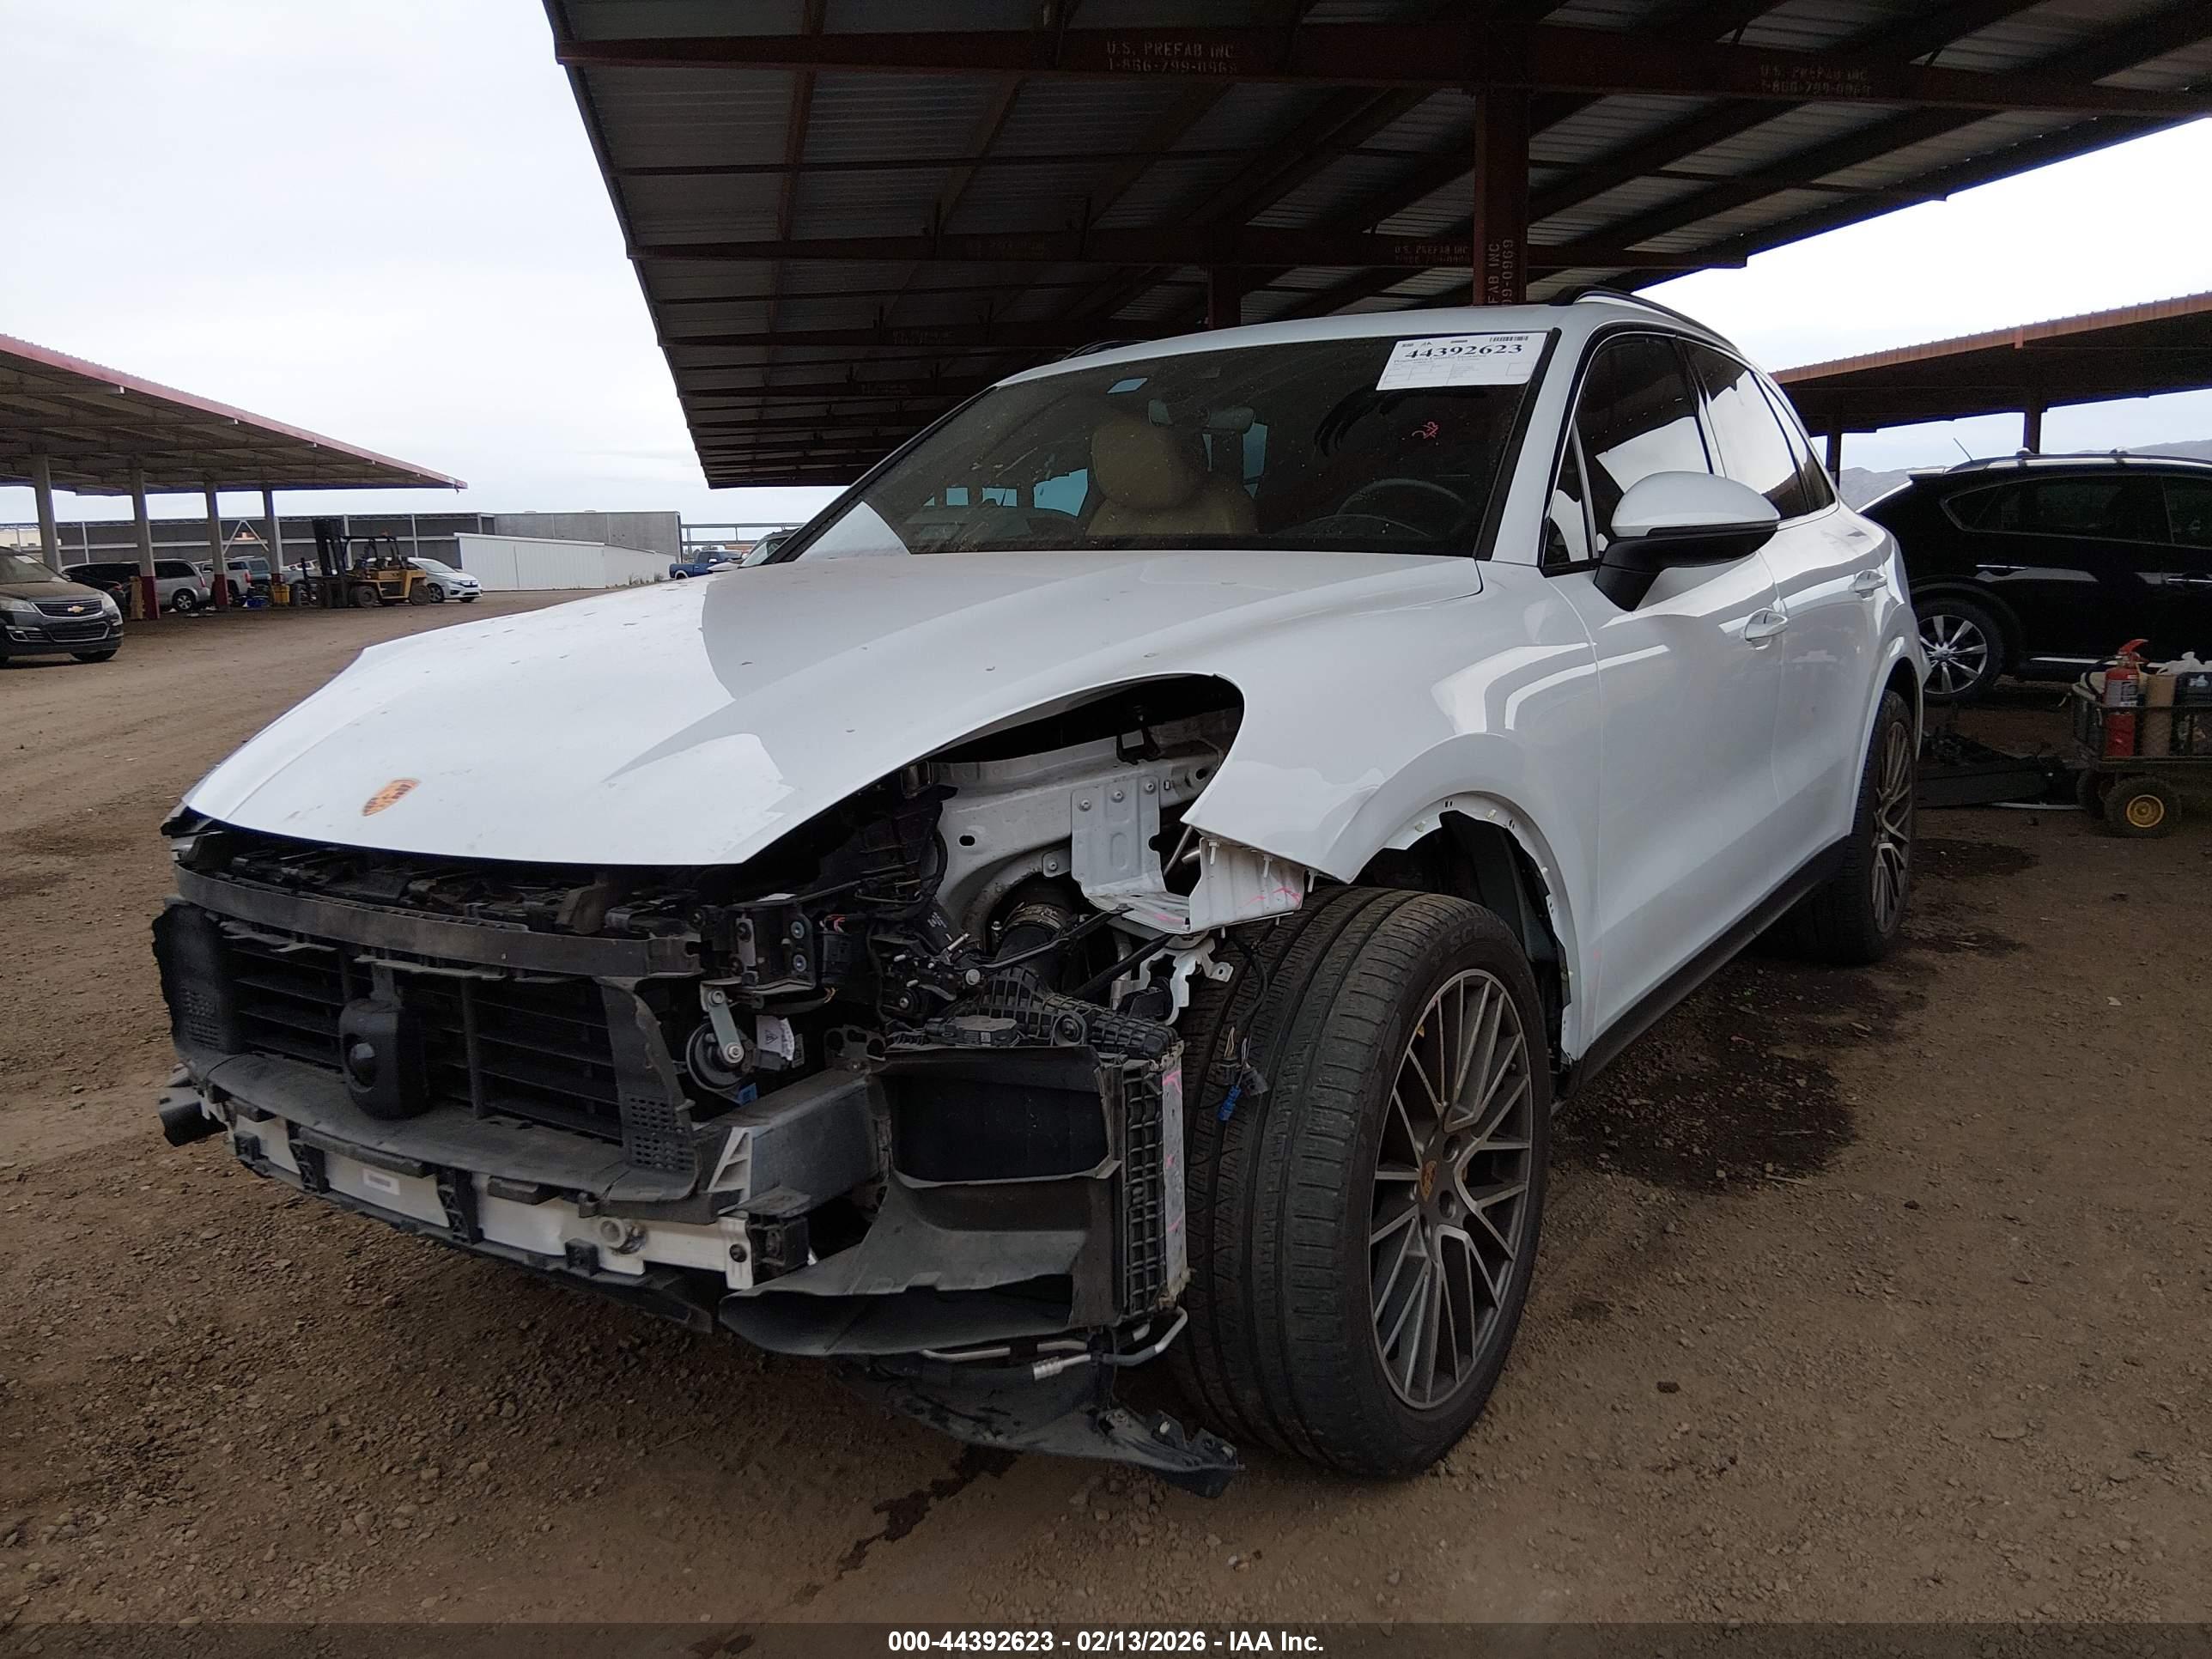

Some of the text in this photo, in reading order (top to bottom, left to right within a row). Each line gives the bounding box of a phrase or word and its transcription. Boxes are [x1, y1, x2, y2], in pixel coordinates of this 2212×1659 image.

[1144, 41, 1203, 58] PREFAB
[1211, 44, 1235, 58] INC
[1487, 243, 1500, 267] INC
[1405, 343, 1522, 359] 44392623
